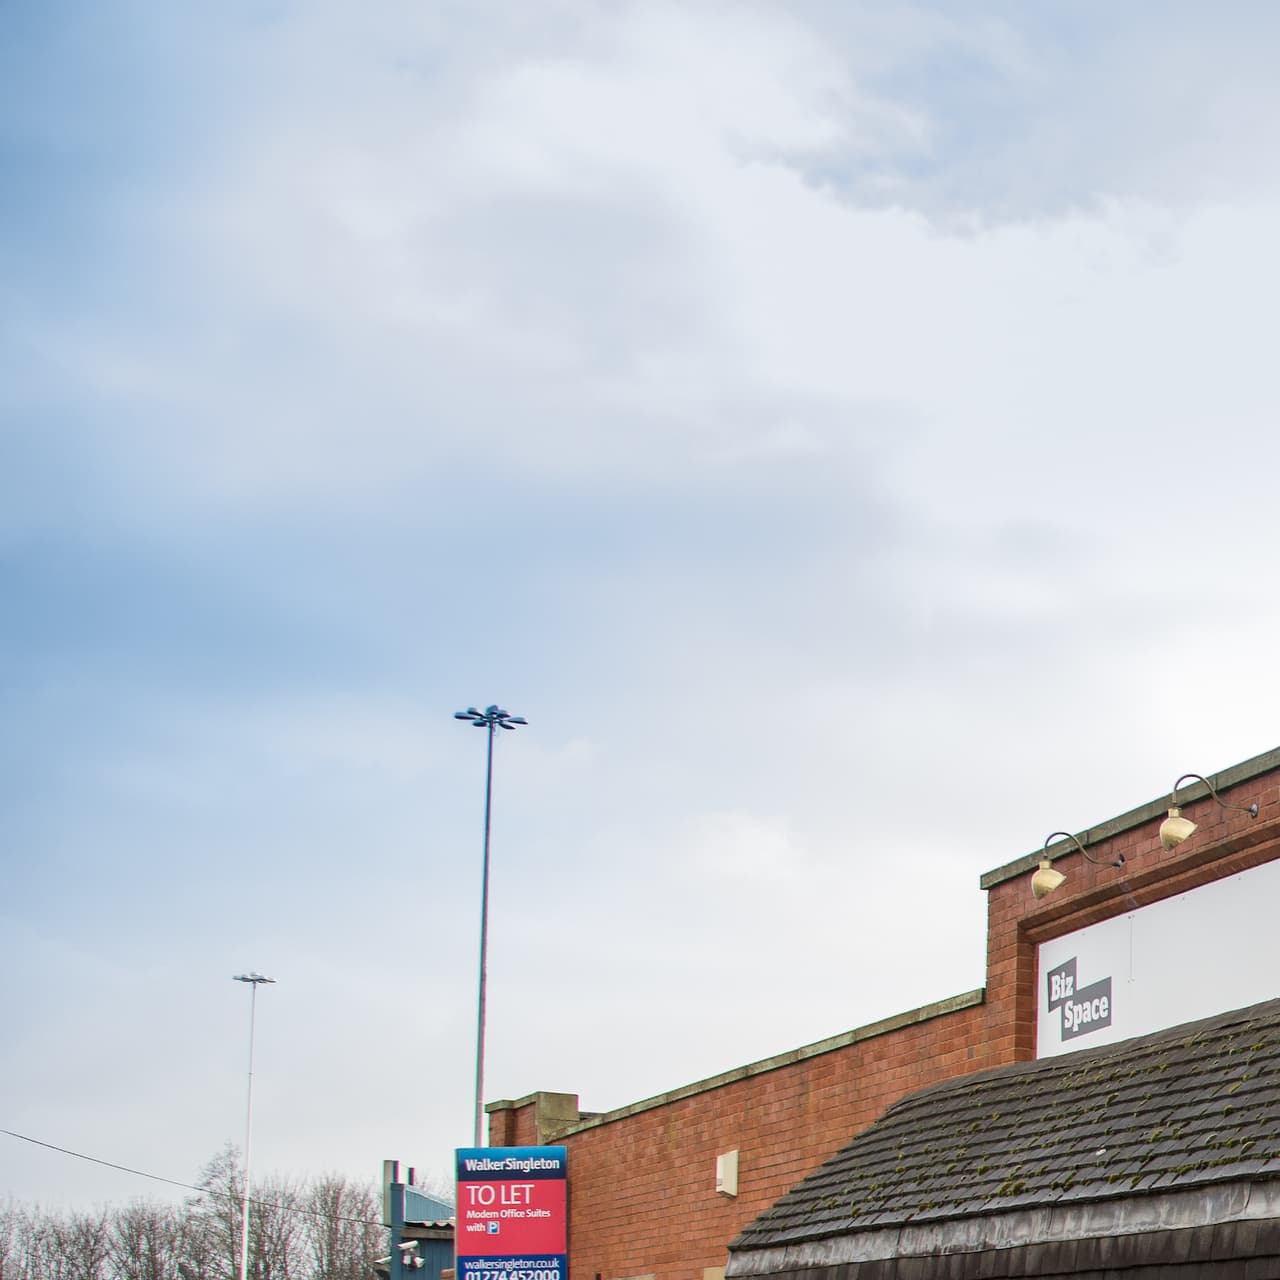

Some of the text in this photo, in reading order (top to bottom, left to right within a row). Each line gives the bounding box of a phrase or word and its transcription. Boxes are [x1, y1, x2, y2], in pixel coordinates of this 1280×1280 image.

[1050, 972, 1074, 1002] Biz
[1064, 996, 1109, 1032] Space
[466, 1184, 535, 1205] TO LET
[466, 1208, 551, 1219] Modern Office Suites
[466, 1222, 486, 1232] with
[464, 1258, 560, 1272] walkersingleton.co.uk
